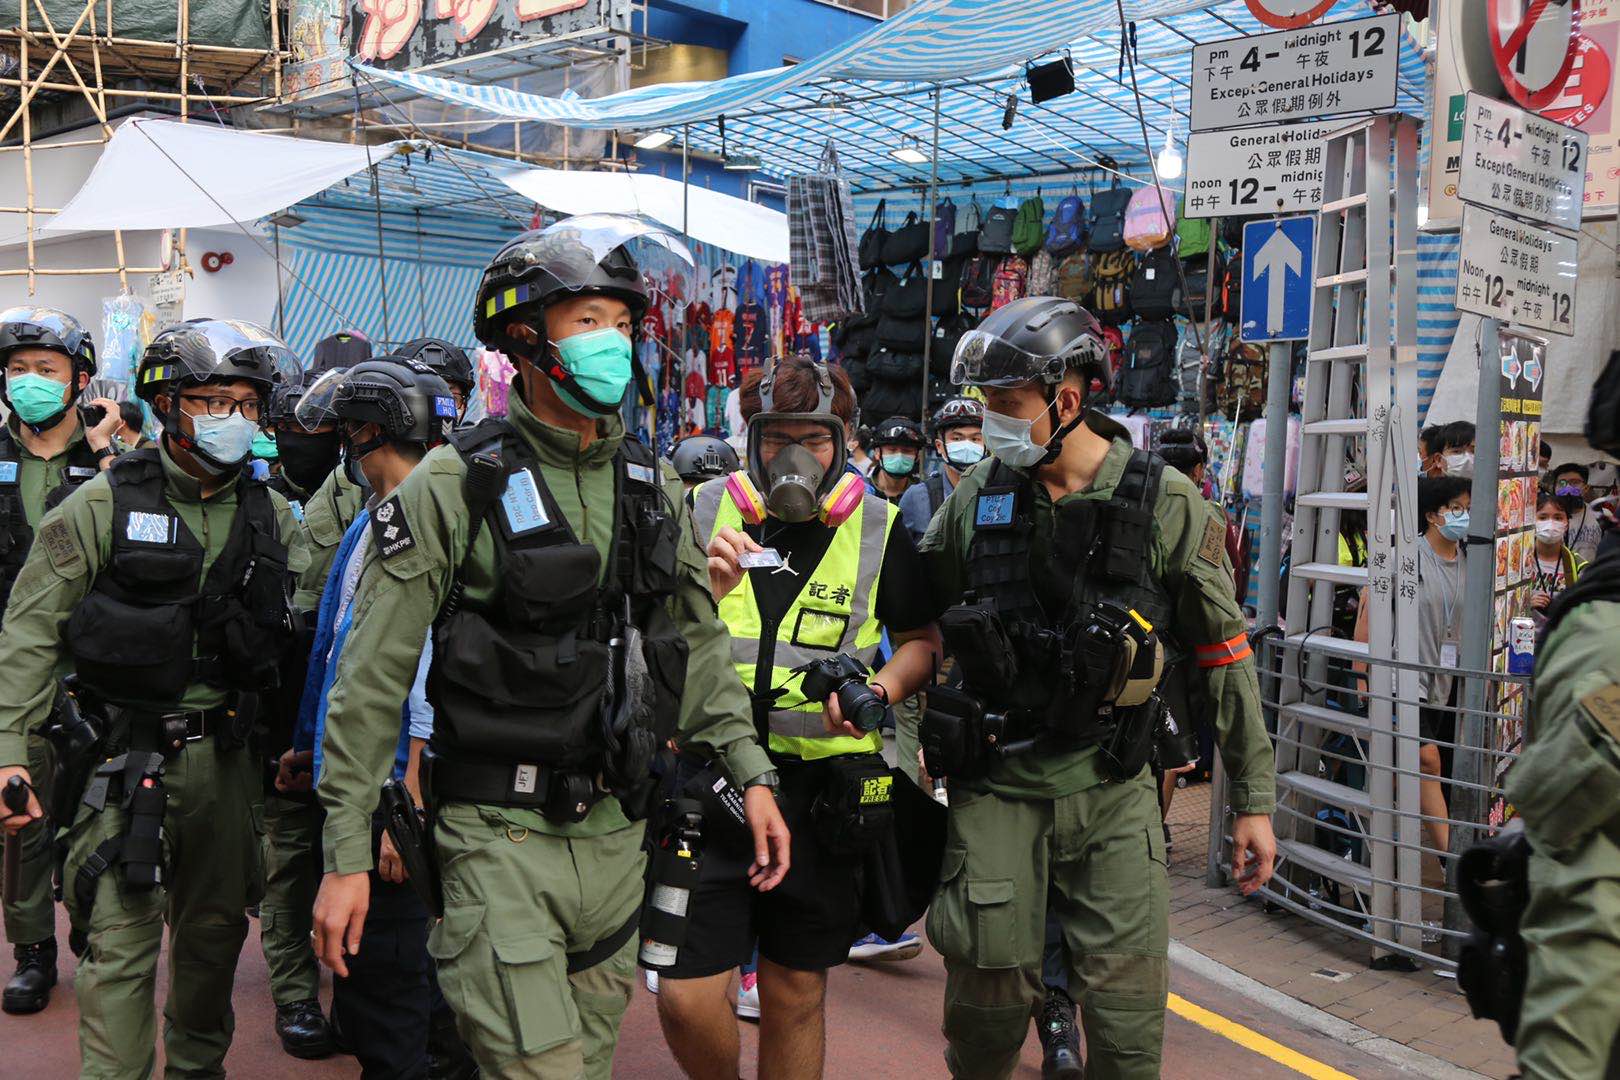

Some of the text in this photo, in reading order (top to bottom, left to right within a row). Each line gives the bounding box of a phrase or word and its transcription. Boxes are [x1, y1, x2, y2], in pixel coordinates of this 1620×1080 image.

[1209, 50, 1229, 64] pm
[1285, 29, 1341, 49] midnight
[1349, 26, 1385, 59] 12
[1204, 51, 1330, 82] 下午 午夜
[1211, 68, 1374, 101] Except General Holidays
[1237, 90, 1341, 118] 公眾假期例外
[1230, 132, 1280, 147] General
[1473, 123, 1551, 167] 下午 午夜
[1477, 106, 1492, 120] pm
[1525, 123, 1559, 144] midnight
[1562, 139, 1580, 172] 12
[1247, 147, 1321, 170] 公眾假期
[1475, 152, 1505, 176] Except
[1506, 163, 1537, 185] General
[1191, 179, 1222, 190] noon
[1191, 194, 1221, 211] 中午
[1490, 220, 1552, 253] General Holidays
[1500, 246, 1539, 273] 公眾假期
[1462, 283, 1543, 320] 中午 午夜
[1463, 259, 1484, 279] Noon
[1517, 278, 1550, 297] midnight
[1552, 292, 1571, 324] 12
[808, 580, 850, 606] 記者
